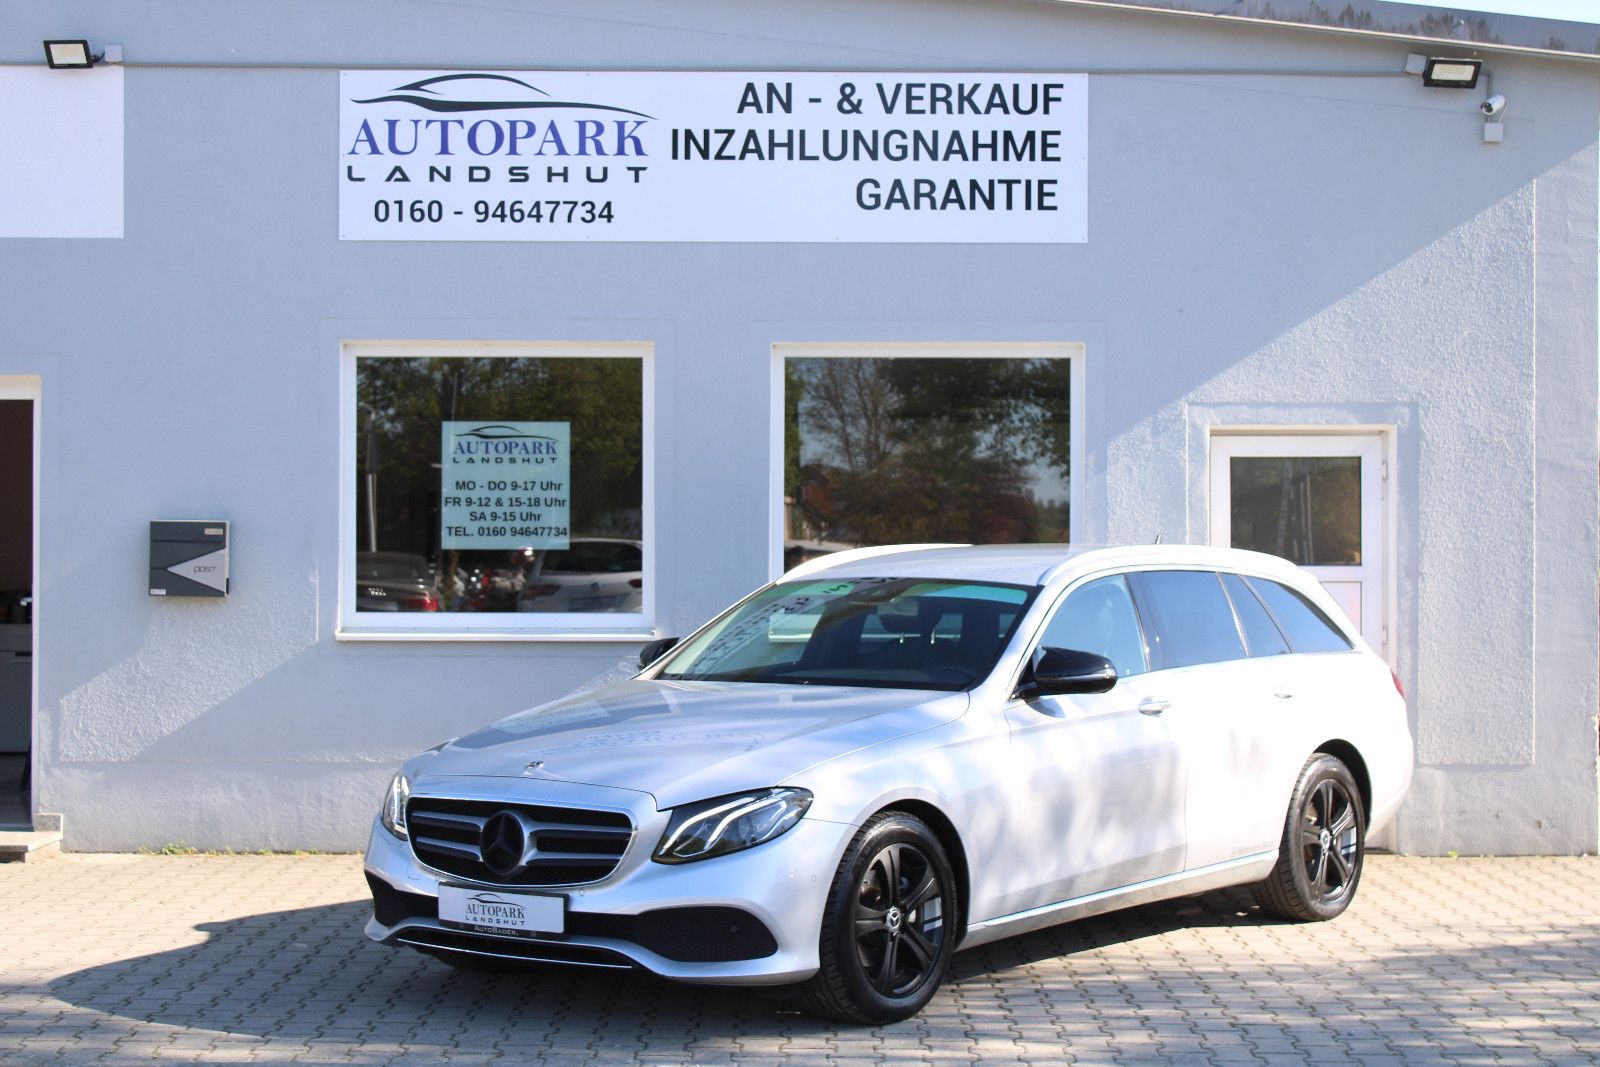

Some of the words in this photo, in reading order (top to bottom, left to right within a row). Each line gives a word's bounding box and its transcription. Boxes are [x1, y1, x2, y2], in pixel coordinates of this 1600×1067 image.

[737, 82, 793, 114] AN
[836, 82, 863, 115] &
[875, 83, 1064, 115] VERKAUF
[347, 118, 649, 156] AUTOPARK
[671, 128, 1062, 162] INZAHLUNGNAHME
[347, 165, 648, 183] LANDSHUT
[856, 178, 1058, 211] GARANTIE
[374, 199, 443, 223] 0160
[473, 200, 614, 224] 94647734
[454, 441, 557, 455] AUTOPARK
[455, 480, 476, 491] MO
[488, 480, 507, 491] DO
[510, 480, 536, 491] 9-17
[540, 480, 563, 491] Uhr
[444, 497, 461, 507] FR
[465, 497, 491, 507] 9-12
[494, 497, 504, 507] &
[508, 497, 541, 507] 15-18
[544, 497, 567, 507] Uhr
[469, 511, 487, 522] SA
[490, 511, 516, 522] 9-15
[520, 511, 542, 522] Uhr
[446, 526, 474, 537] TEL.
[478, 526, 507, 537] 0160
[510, 526, 568, 537] 94647734
[465, 903, 525, 919] AUTOPARK
[465, 916, 525, 926] LANDSHUT
